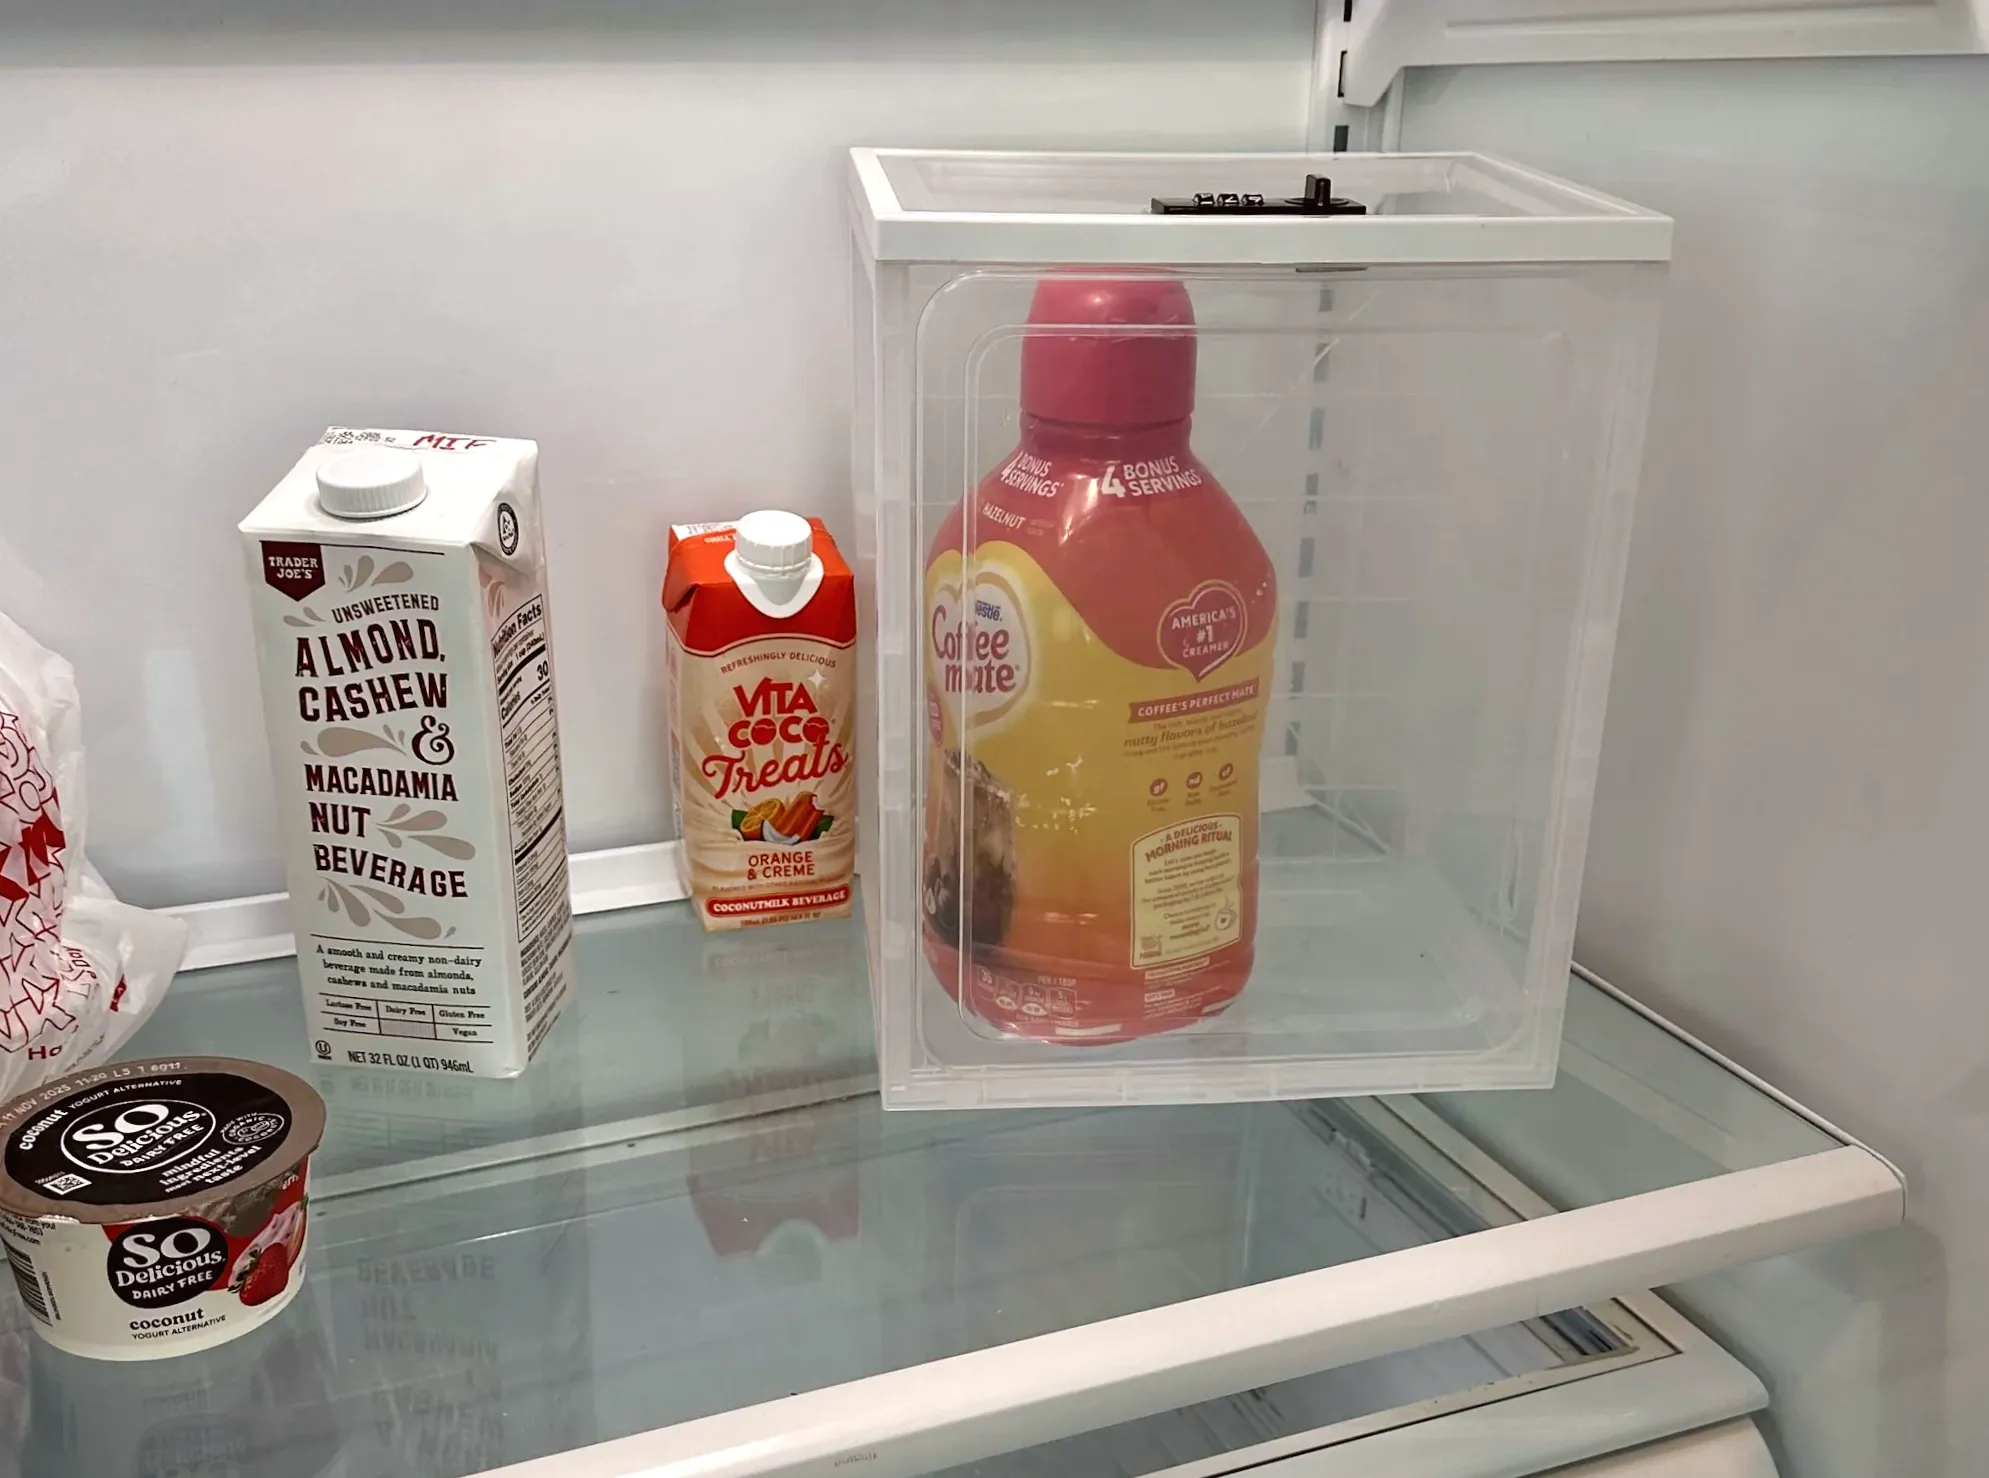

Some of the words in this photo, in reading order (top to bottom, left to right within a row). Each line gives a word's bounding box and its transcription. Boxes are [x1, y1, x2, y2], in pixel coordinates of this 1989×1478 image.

[1001, 450, 1024, 481] 4
[1018, 453, 1052, 477] BONUS
[1101, 465, 1126, 498] 4
[1123, 456, 1179, 480] BONUS
[1127, 468, 1202, 497] SERVINGS
[982, 502, 1026, 529] HAZELNUT
[268, 556, 320, 568] TRADER
[276, 568, 313, 579] JOE'S
[331, 593, 440, 624] UNSWEETENED
[517, 603, 542, 629] Facts
[1172, 606, 1236, 630] AMERICA'S
[1197, 625, 1214, 643] #1
[720, 651, 786, 674] REFRESHINGLY
[789, 652, 836, 668] DELICIOUS
[1183, 641, 1229, 658] CREAMER
[536, 659, 549, 682] 30
[298, 671, 448, 722] CASHEW
[733, 676, 818, 718] VITA
[1137, 701, 1188, 717] COFFEE'S
[1190, 692, 1230, 709] PERFECT
[411, 715, 455, 766] &
[728, 715, 830, 749] COCO
[1160, 726, 1203, 742] flavors
[702, 733, 848, 800] Treats
[304, 763, 460, 802] MACADAMIA
[308, 801, 372, 838] NUT
[1165, 833, 1173, 842] A
[1173, 821, 1218, 839] DELICIOUS
[748, 850, 813, 867] ORANGE
[1144, 835, 1199, 862] MORNING
[1200, 829, 1233, 844] RITUAL
[313, 843, 469, 898] BEVERAGE
[747, 868, 757, 880] &
[762, 863, 816, 879] CREME
[713, 897, 790, 912] COCONUTMILK
[792, 890, 846, 906] BEVERAGE
[316, 944, 324, 954] A
[327, 947, 363, 959] smooth
[365, 950, 384, 960] and
[387, 953, 424, 965] creamy
[428, 955, 482, 967] non-dairy
[322, 959, 366, 974] beverage
[369, 966, 395, 975] made
[398, 967, 424, 978] from
[427, 969, 474, 981] almonds,
[327, 976, 368, 987] cashews
[370, 980, 389, 989] and
[392, 982, 448, 994] macadamia
[452, 985, 476, 995] nuts
[325, 999, 353, 1009] Lactose
[354, 1002, 372, 1011] Free
[385, 1005, 407, 1015] Dairy
[409, 1007, 426, 1016] Free
[439, 1009, 465, 1018] Gluten
[467, 1010, 485, 1019] Free
[333, 1018, 348, 1027] Soy
[349, 1019, 367, 1028] Free
[451, 1027, 478, 1037] Vegan
[347, 1050, 367, 1063] NET
[368, 1053, 382, 1065] 32
[382, 1054, 396, 1066] FL
[396, 1055, 410, 1067] OZ
[440, 1059, 474, 1073] 946mL
[14, 1098, 38, 1115] NOV
[39, 1084, 72, 1100] 2025
[19, 1109, 69, 1151] coconut
[68, 1089, 110, 1110] YOGURT
[113, 1079, 182, 1094] ALTERNATIVE
[72, 1103, 169, 1150] SO
[119, 1143, 167, 1167] DAIRY
[163, 1123, 205, 1145] FREE
[159, 1146, 244, 1185] ingredients
[162, 1148, 221, 1177] mindful
[192, 1145, 262, 1182] next-level
[205, 1164, 243, 1184] taste
[122, 1227, 211, 1268] SO
[132, 1282, 175, 1300] DAIRY
[177, 1270, 213, 1288] FREE
[129, 1307, 205, 1330] coconut
[132, 1329, 169, 1340] YOGURT
[171, 1314, 226, 1335] ALTERNATIVE
